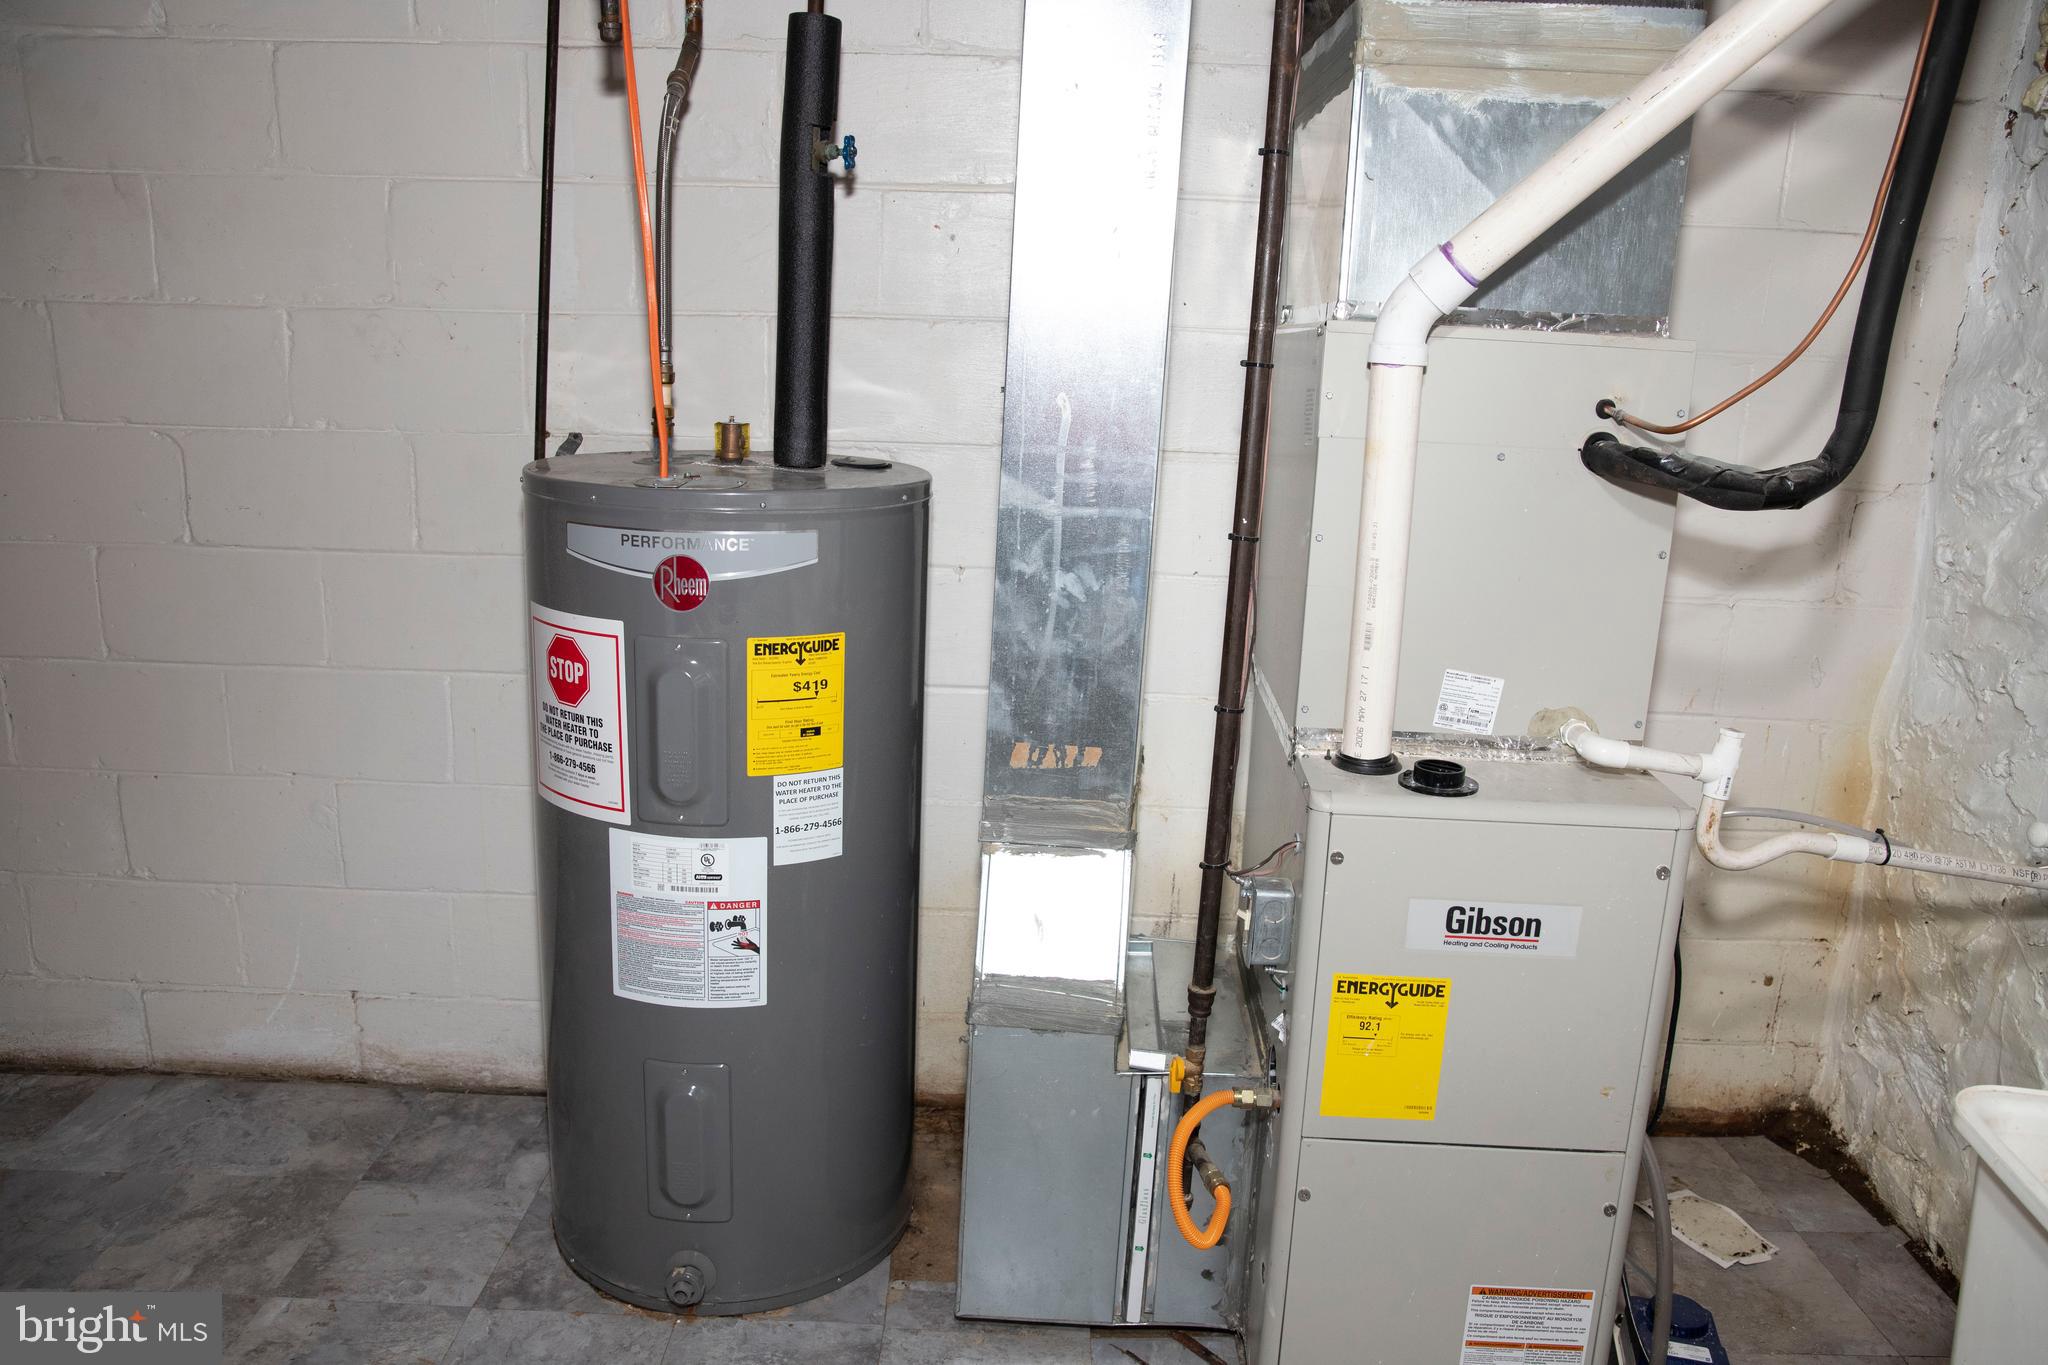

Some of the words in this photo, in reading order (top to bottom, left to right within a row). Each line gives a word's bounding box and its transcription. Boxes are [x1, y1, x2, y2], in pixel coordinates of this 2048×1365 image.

[620, 534, 749, 552] PERFORMANCE
[659, 556, 707, 603] Rheem
[754, 638, 840, 657] ENERGYGUIDE
[550, 656, 584, 684] STOP
[793, 678, 828, 692] $419
[542, 702, 548, 712] DO
[549, 704, 558, 716] NOT
[560, 709, 584, 724] RETURN
[586, 716, 604, 728] THIS
[545, 714, 561, 729] WATER
[562, 721, 587, 736] HEATER
[589, 728, 598, 738] TO
[548, 726, 564, 741] PLACE
[565, 733, 572, 743] OF
[574, 736, 613, 753] PURCHASE
[549, 751, 596, 774] 1-866-279-4566
[803, 776, 827, 784] RETURN
[809, 792, 838, 801] PURCHASE
[776, 818, 842, 834] 1-866-279-4566
[1446, 906, 1542, 937] Gibson
[1443, 940, 1469, 948] Heating
[1337, 980, 1446, 998] ENERGYGUIDE
[1360, 1021, 1380, 1031] 92.1
